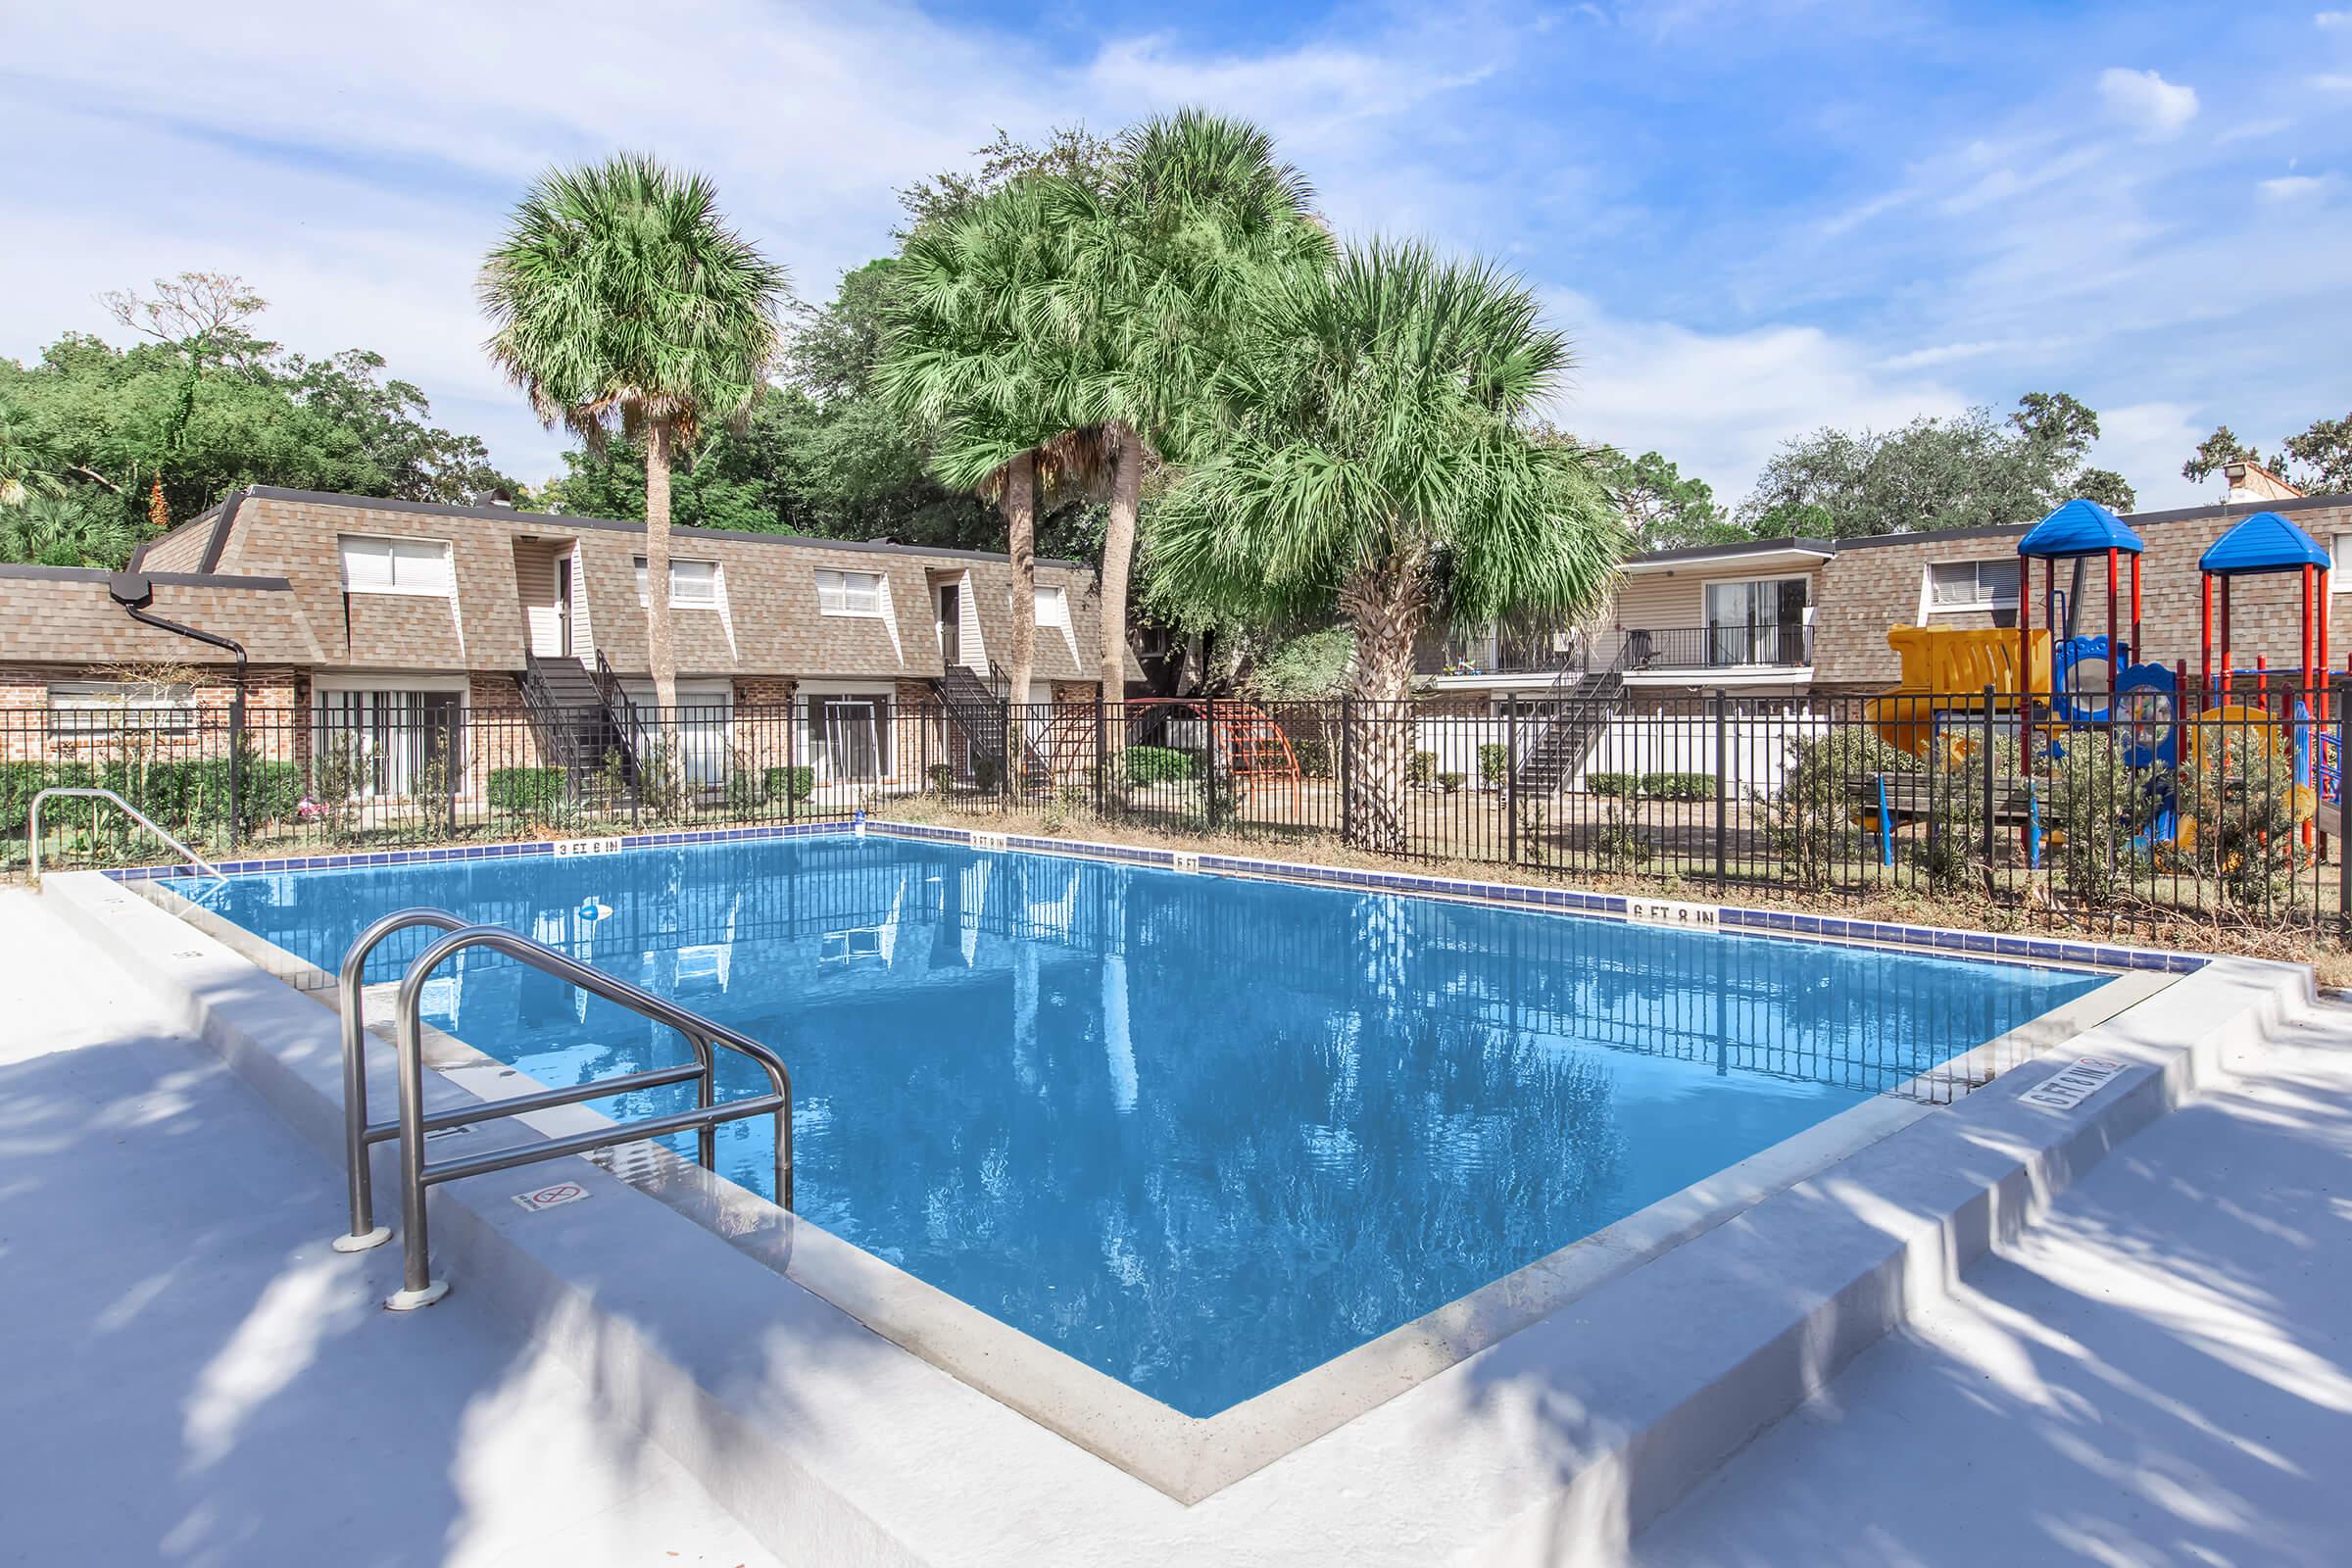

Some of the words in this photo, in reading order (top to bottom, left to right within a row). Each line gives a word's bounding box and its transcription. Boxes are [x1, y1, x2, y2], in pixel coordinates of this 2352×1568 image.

[1650, 906, 1669, 919] FT
[1696, 909, 1714, 925] IN
[2069, 1066, 2111, 1080] IN
[2060, 1076, 2096, 1086] 8
[2040, 1082, 2086, 1098] FT
[2030, 1095, 2071, 1105] 6
